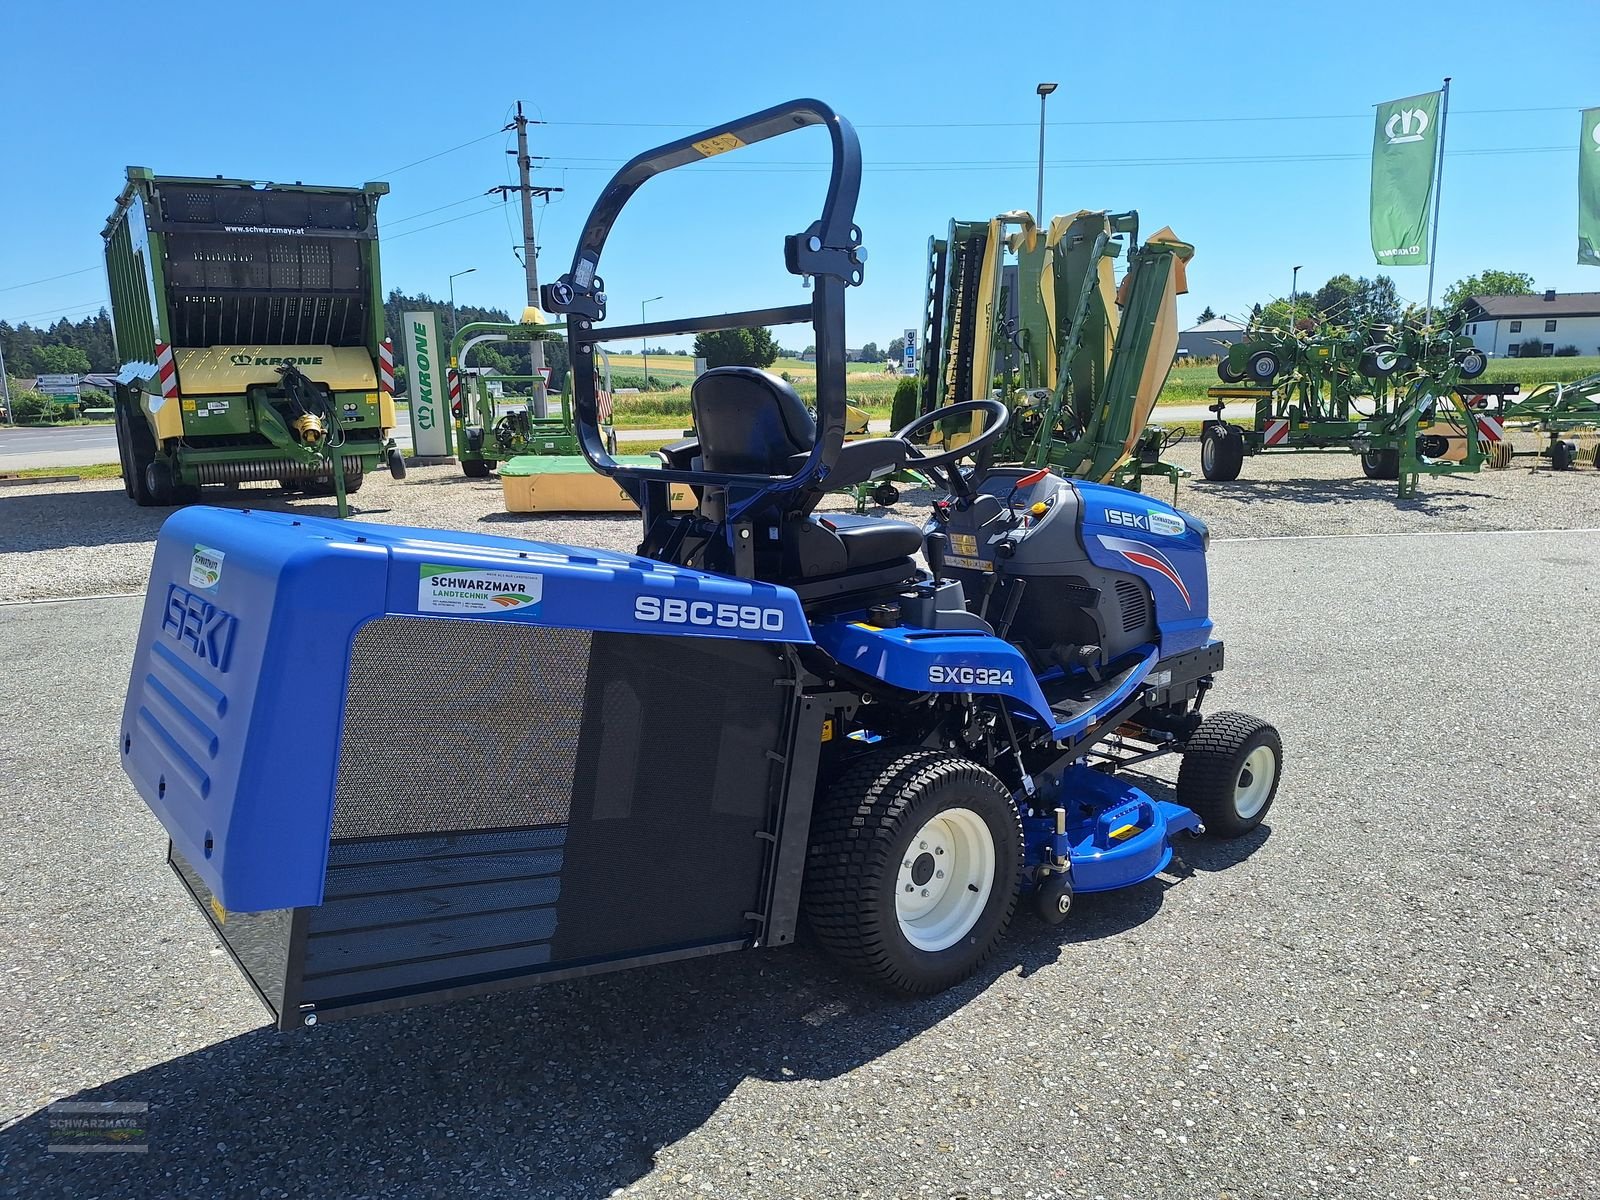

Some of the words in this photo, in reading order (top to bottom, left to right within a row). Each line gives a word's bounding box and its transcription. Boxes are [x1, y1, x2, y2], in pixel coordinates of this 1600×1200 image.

[224, 226, 305, 235] www.schwarzmayr.at
[255, 357, 323, 365] KRONE
[413, 321, 432, 404] KRONE
[1104, 508, 1150, 530] ISEKI
[432, 577, 526, 592] SCHWARZMAYR
[433, 590, 489, 600] LANDTECHNIK
[634, 596, 784, 632] SBC590
[161, 584, 239, 673] ISEKI
[929, 666, 1014, 686] SXG324
